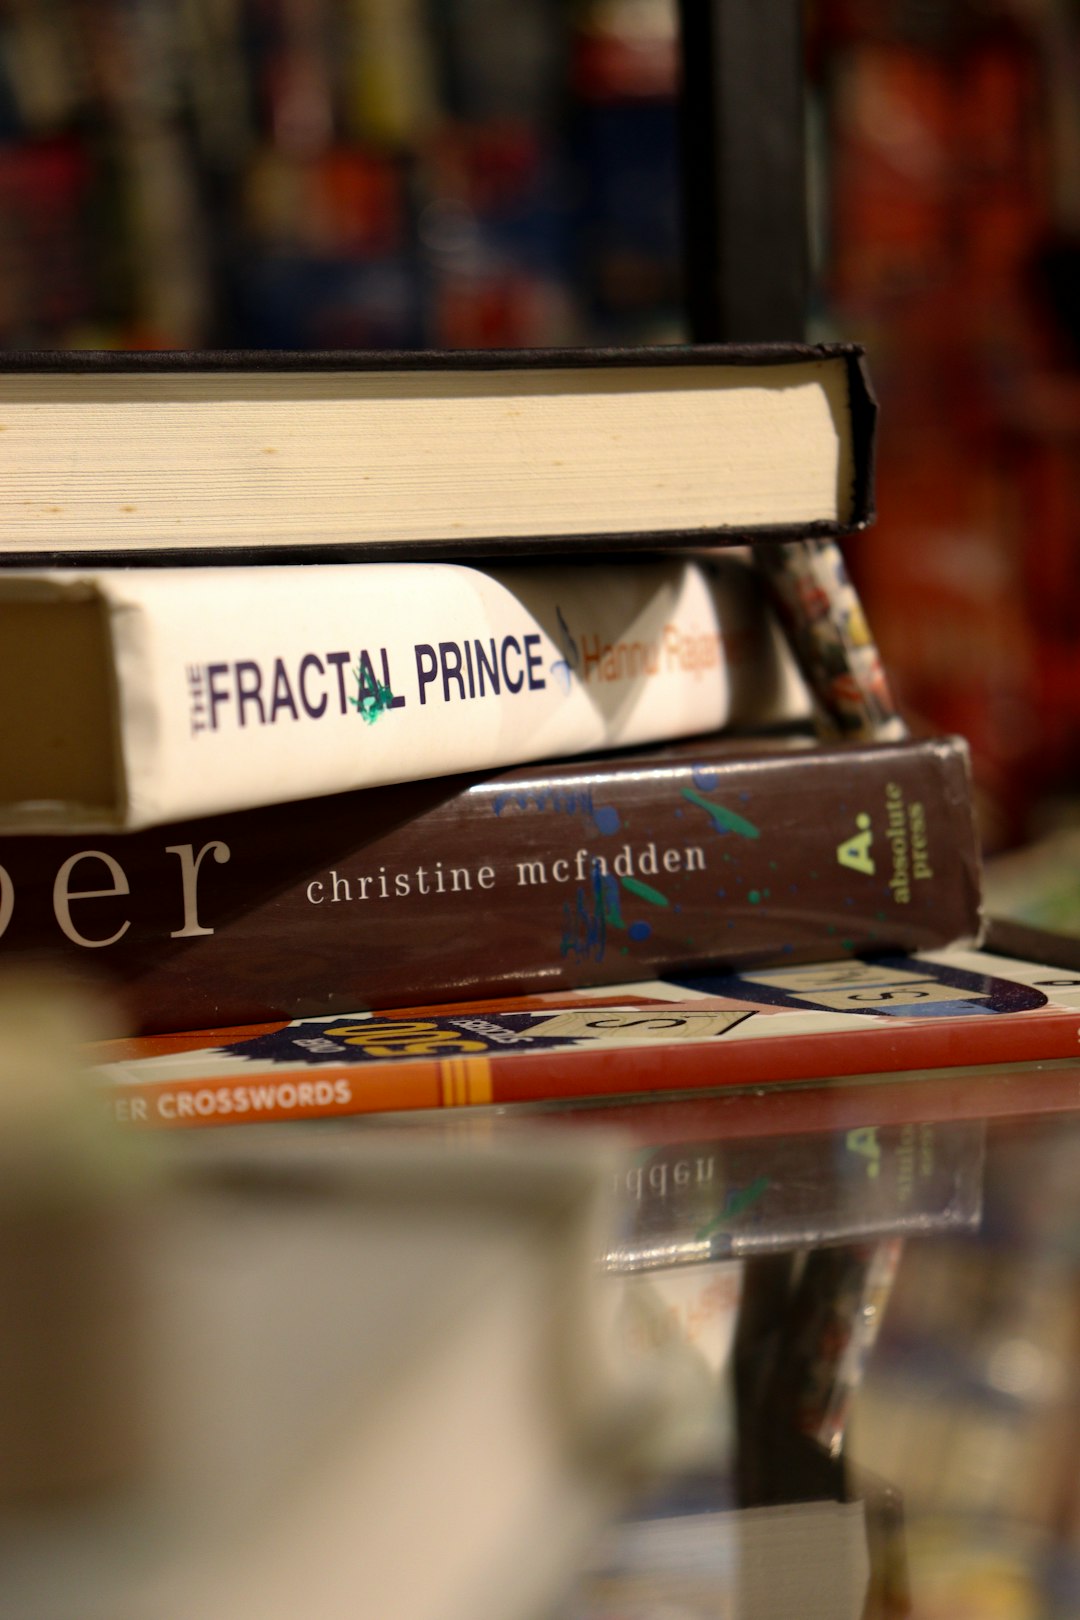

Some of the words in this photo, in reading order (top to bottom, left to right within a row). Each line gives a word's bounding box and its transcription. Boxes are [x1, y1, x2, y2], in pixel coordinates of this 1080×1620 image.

[186, 663, 206, 738] THE
[207, 648, 406, 731] FRACTAL
[415, 634, 546, 705] PRINCE
[306, 861, 496, 904] christine
[516, 843, 706, 886] mcfadden
[886, 782, 911, 904] absolute
[909, 802, 934, 879] press
[292, 1037, 347, 1054] OVER
[323, 1022, 489, 1057] 500
[110, 1095, 148, 1122] ER
[157, 1079, 352, 1119] CROSSWORDS
